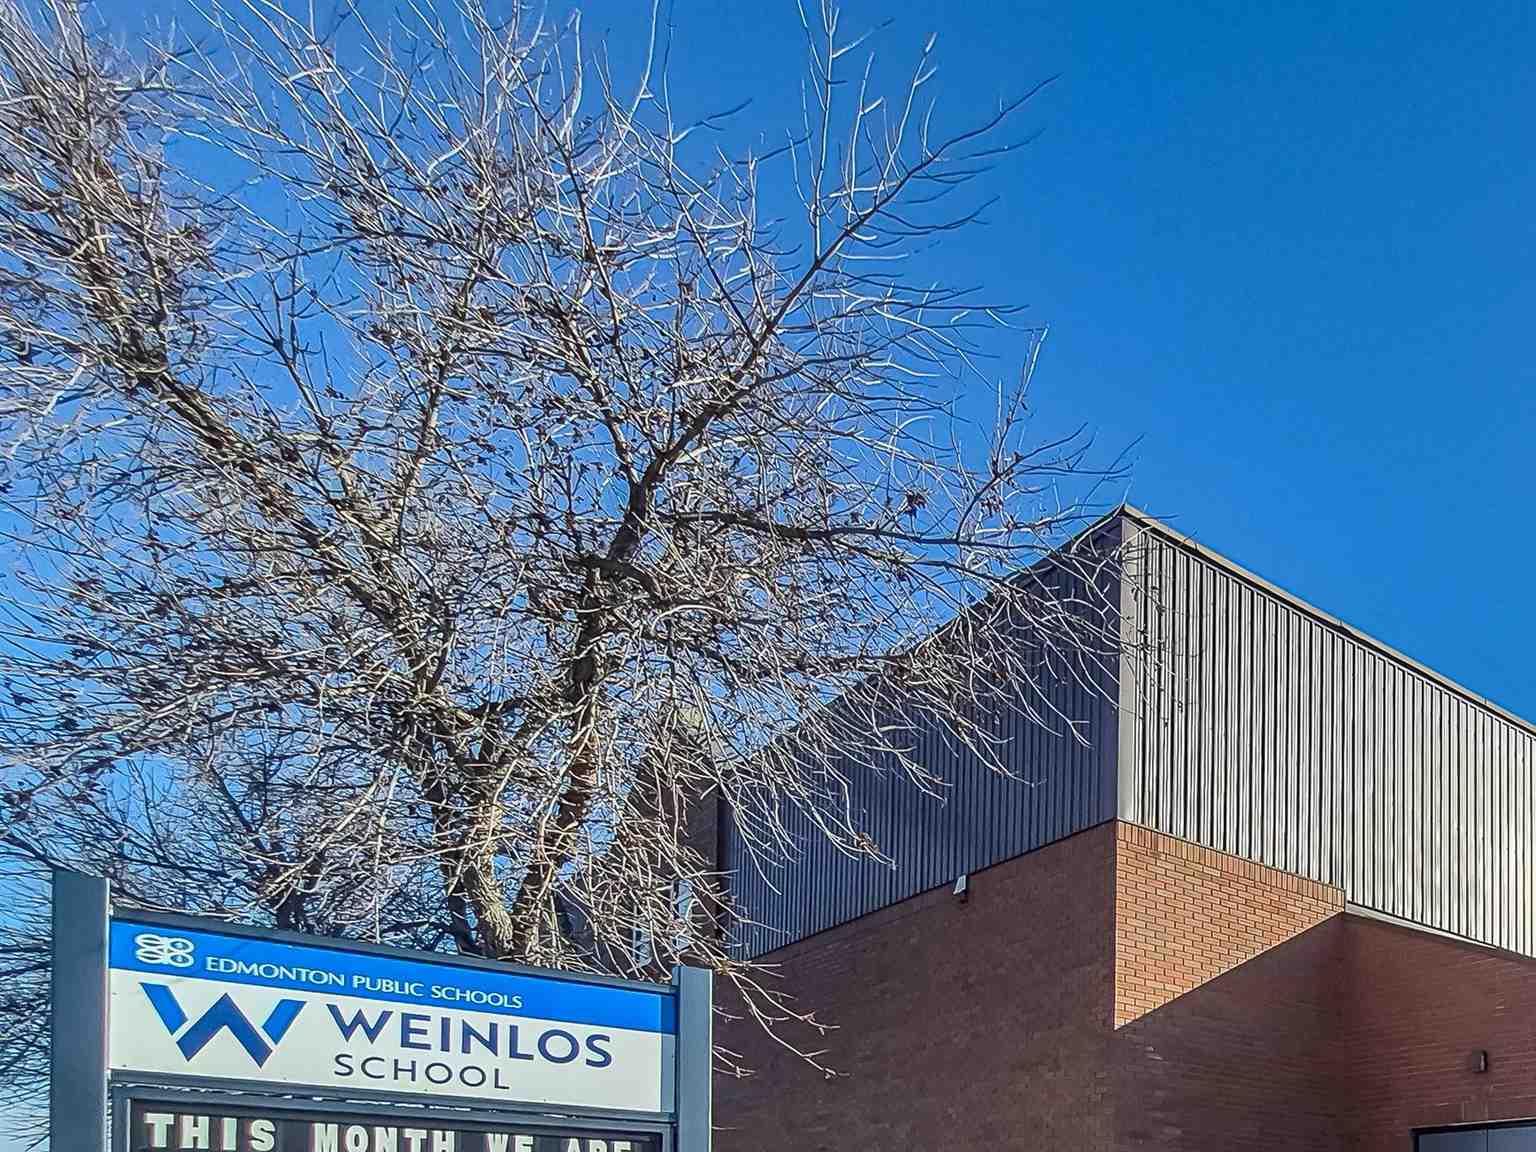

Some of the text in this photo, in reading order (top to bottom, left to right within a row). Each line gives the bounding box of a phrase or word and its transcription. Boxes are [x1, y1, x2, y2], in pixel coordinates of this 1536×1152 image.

[206, 956, 523, 1009] EDMONTON PUBLIC SCHOOLS
[326, 1003, 613, 1068] WEINLOS
[334, 1053, 510, 1090] SCHOOL
[144, 1112, 276, 1151] THIS
